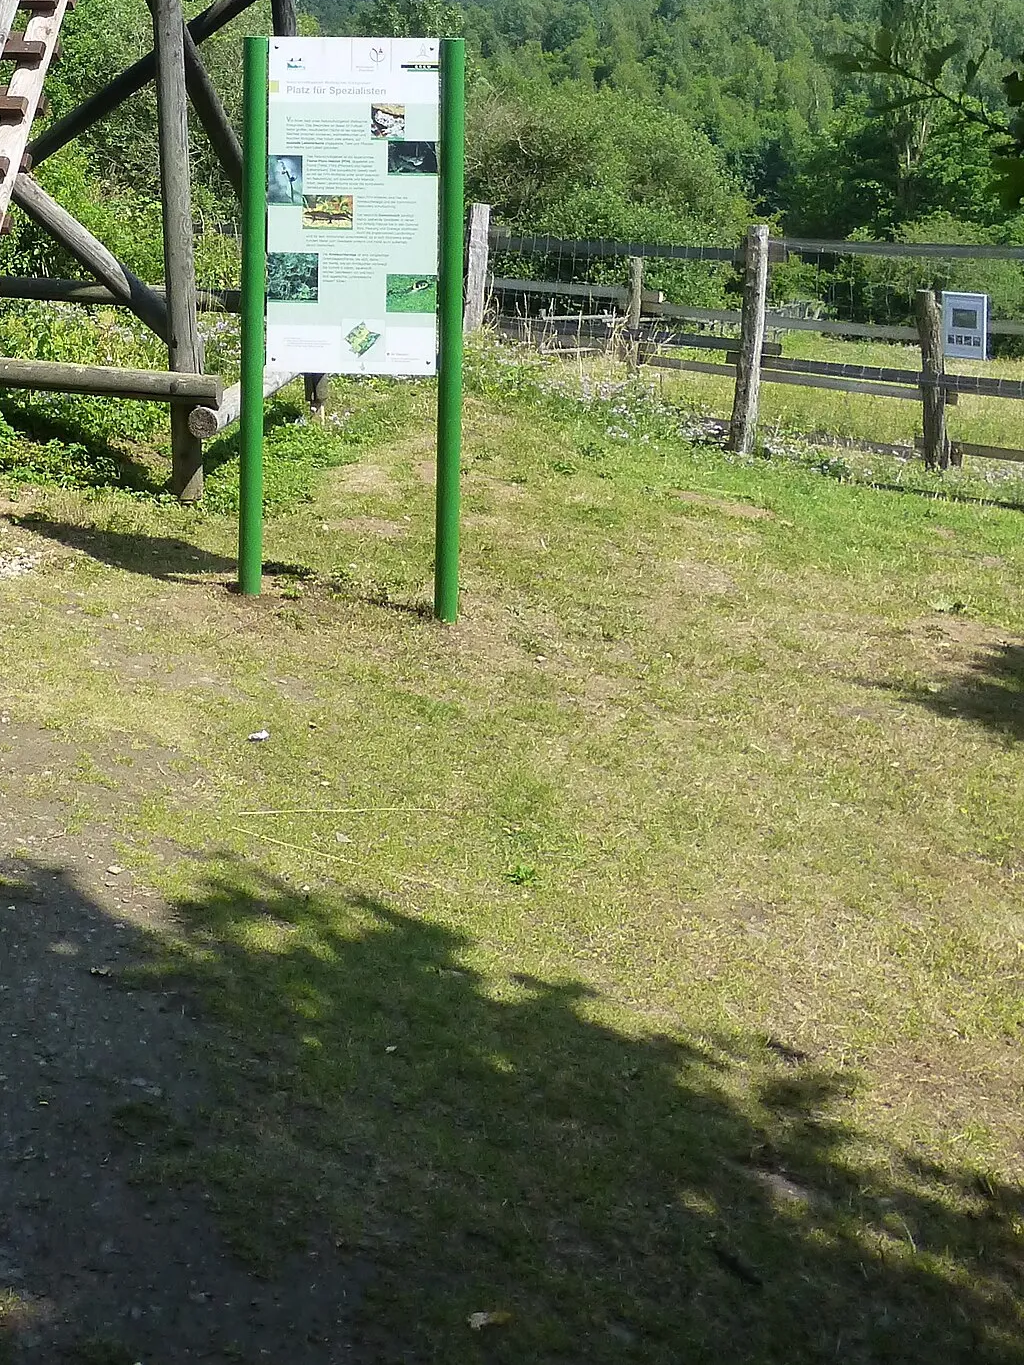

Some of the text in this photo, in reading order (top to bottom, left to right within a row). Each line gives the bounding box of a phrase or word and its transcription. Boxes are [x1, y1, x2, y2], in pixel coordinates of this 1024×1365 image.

[286, 85, 387, 96] Platz für Spezialisten
